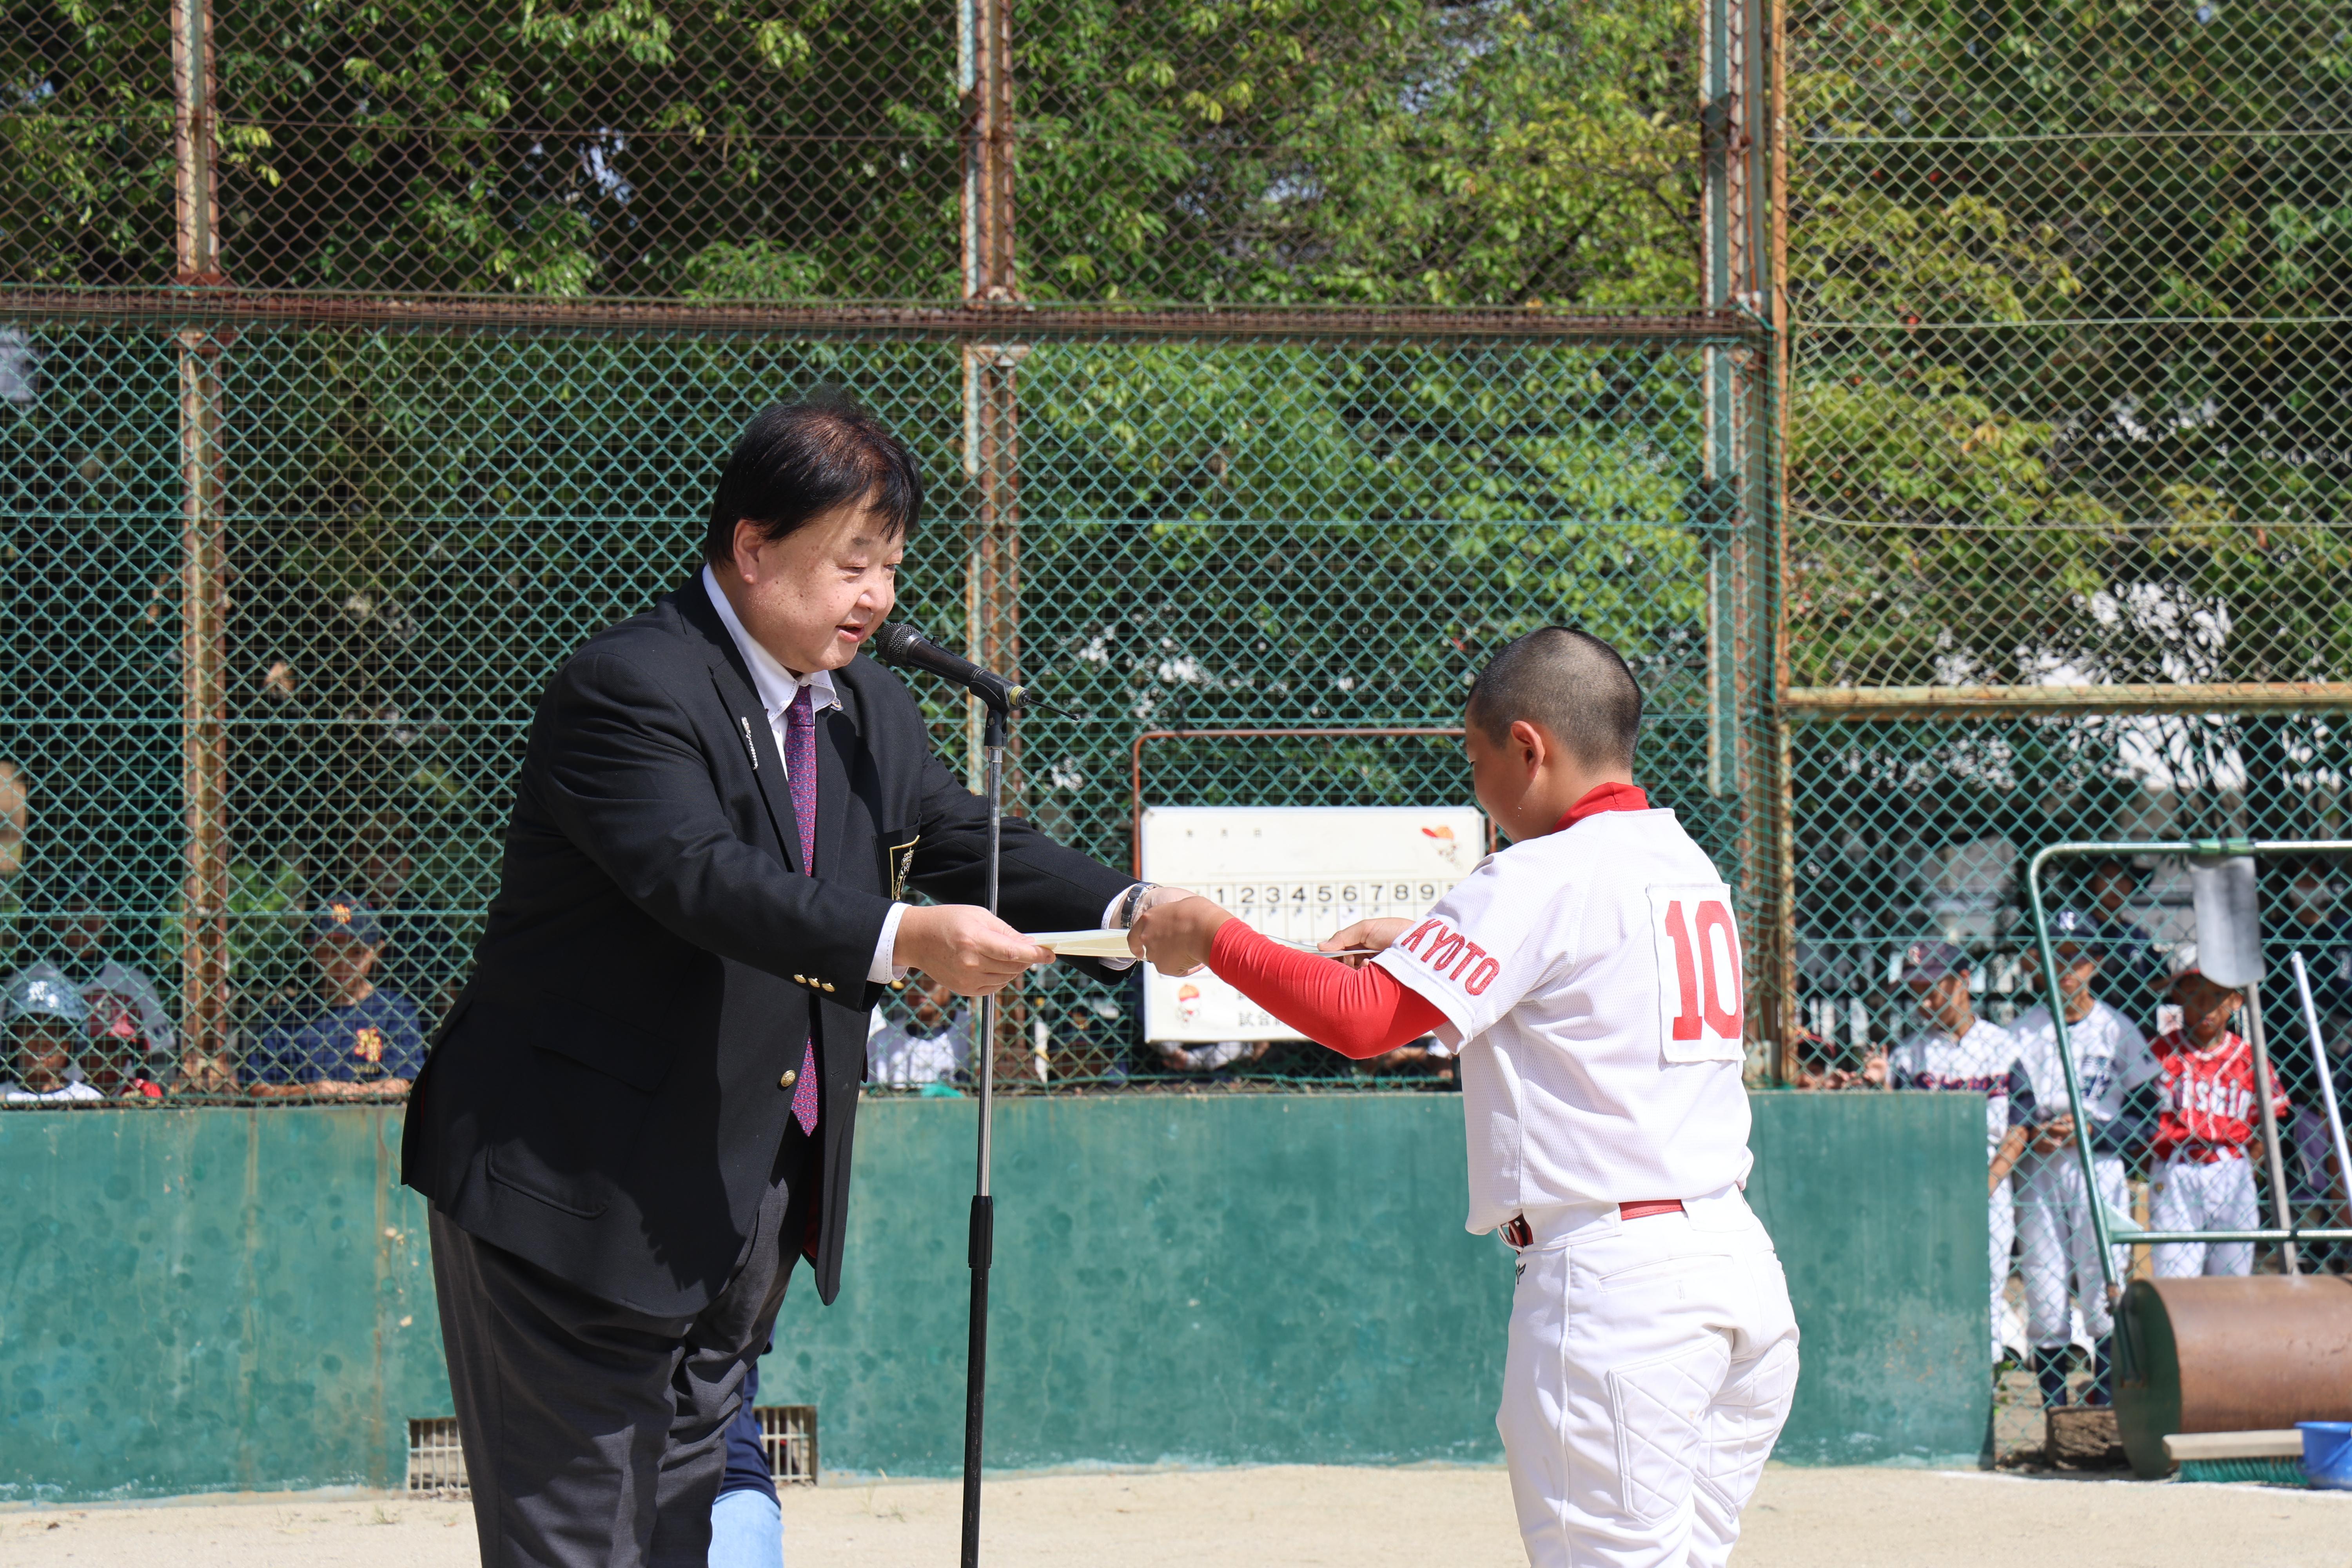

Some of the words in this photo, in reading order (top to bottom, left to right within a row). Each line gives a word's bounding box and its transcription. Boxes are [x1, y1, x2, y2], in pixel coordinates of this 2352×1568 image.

[1217, 887, 1223, 903] 1
[1241, 887, 1254, 902] 2
[1266, 886, 1280, 902] 3
[1292, 886, 1305, 902] 4
[1318, 886, 1332, 901] 5
[1343, 885, 1357, 901] 6
[1371, 885, 1382, 900] 7
[1395, 884, 1408, 900] 8
[1420, 884, 1434, 900] 9
[1401, 918, 1500, 996] KYOTO
[1665, 900, 1741, 1041] 10
